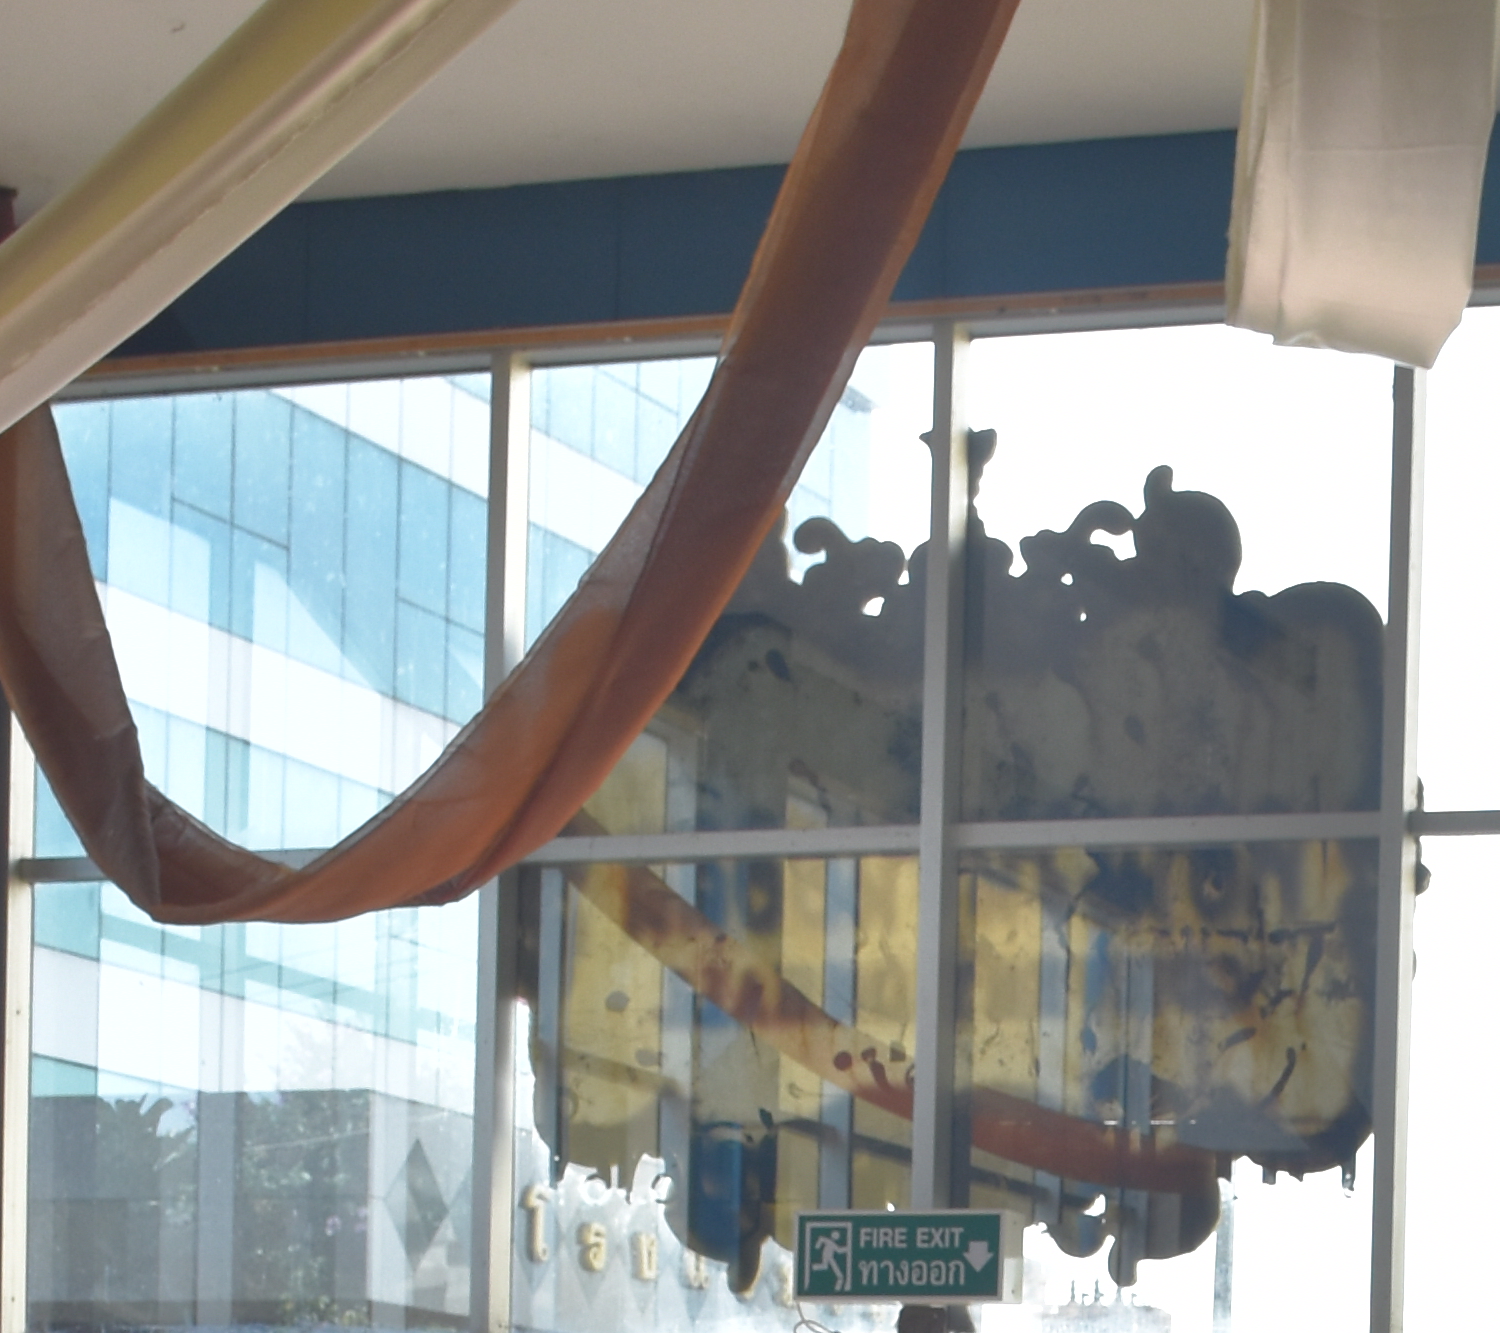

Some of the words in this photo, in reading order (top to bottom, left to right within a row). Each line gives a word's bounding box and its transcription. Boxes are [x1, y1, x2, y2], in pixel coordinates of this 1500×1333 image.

[859, 1227, 907, 1249] FIRE
[916, 1227, 964, 1249] EXIT
[858, 1259, 966, 1286] ทางออก
